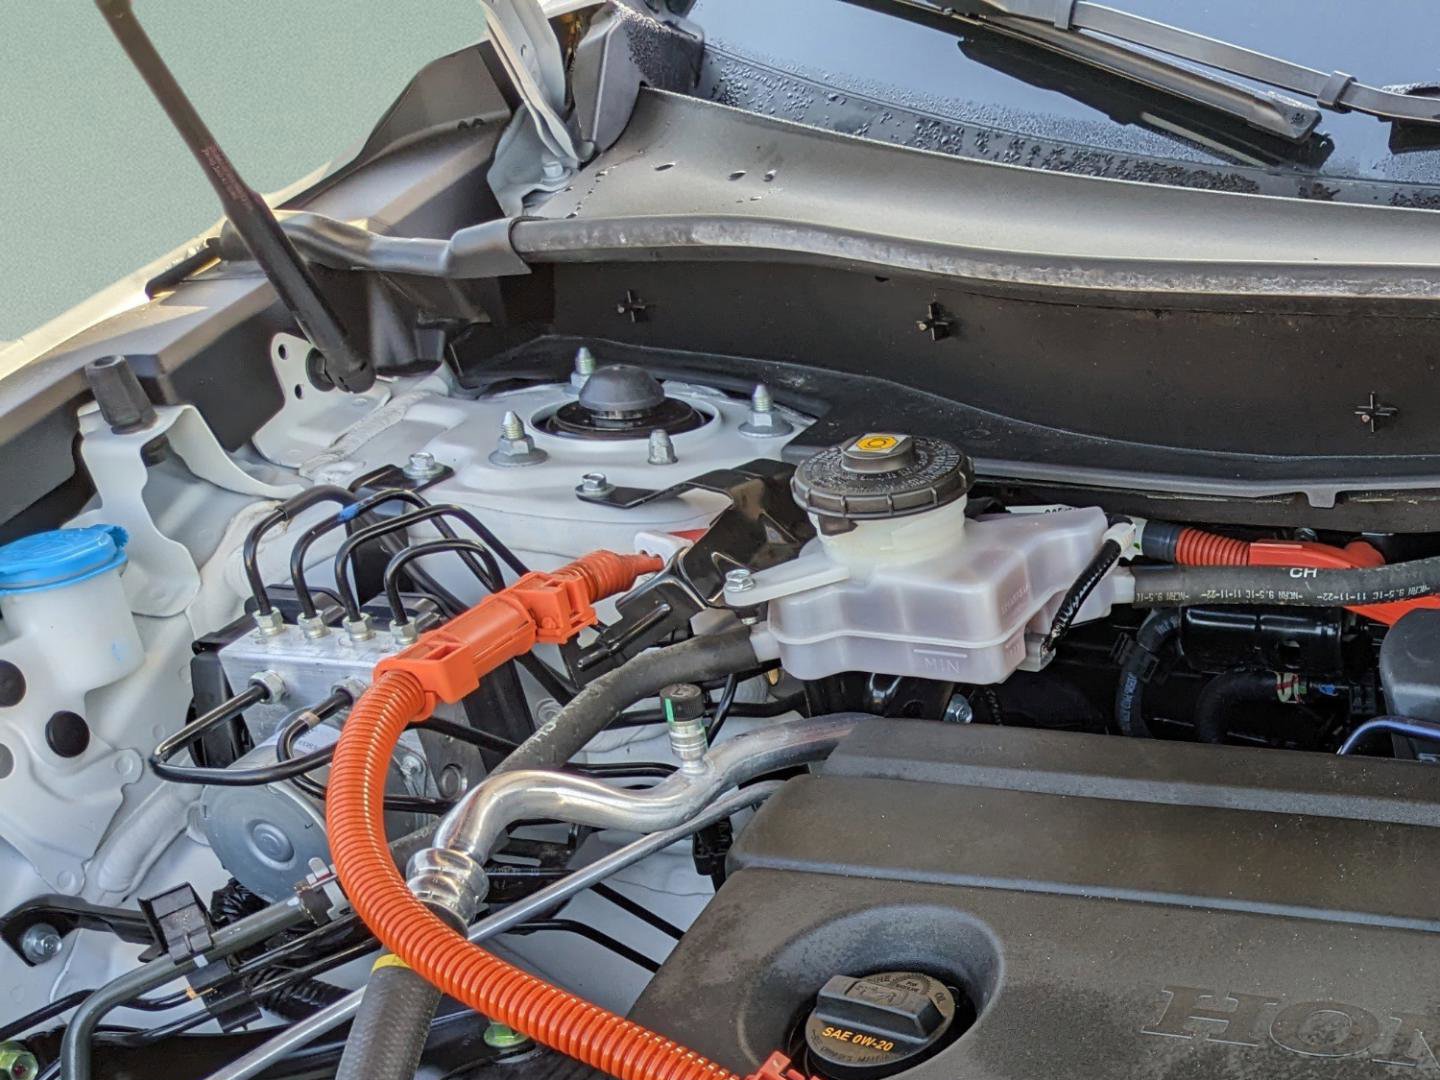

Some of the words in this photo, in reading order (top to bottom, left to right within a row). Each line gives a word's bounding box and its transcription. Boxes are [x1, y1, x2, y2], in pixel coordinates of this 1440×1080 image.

[1289, 568, 1318, 579] CH
[923, 657, 961, 674] MIN
[821, 1026, 853, 1043] SAE
[852, 1034, 895, 1052] 0W-20
